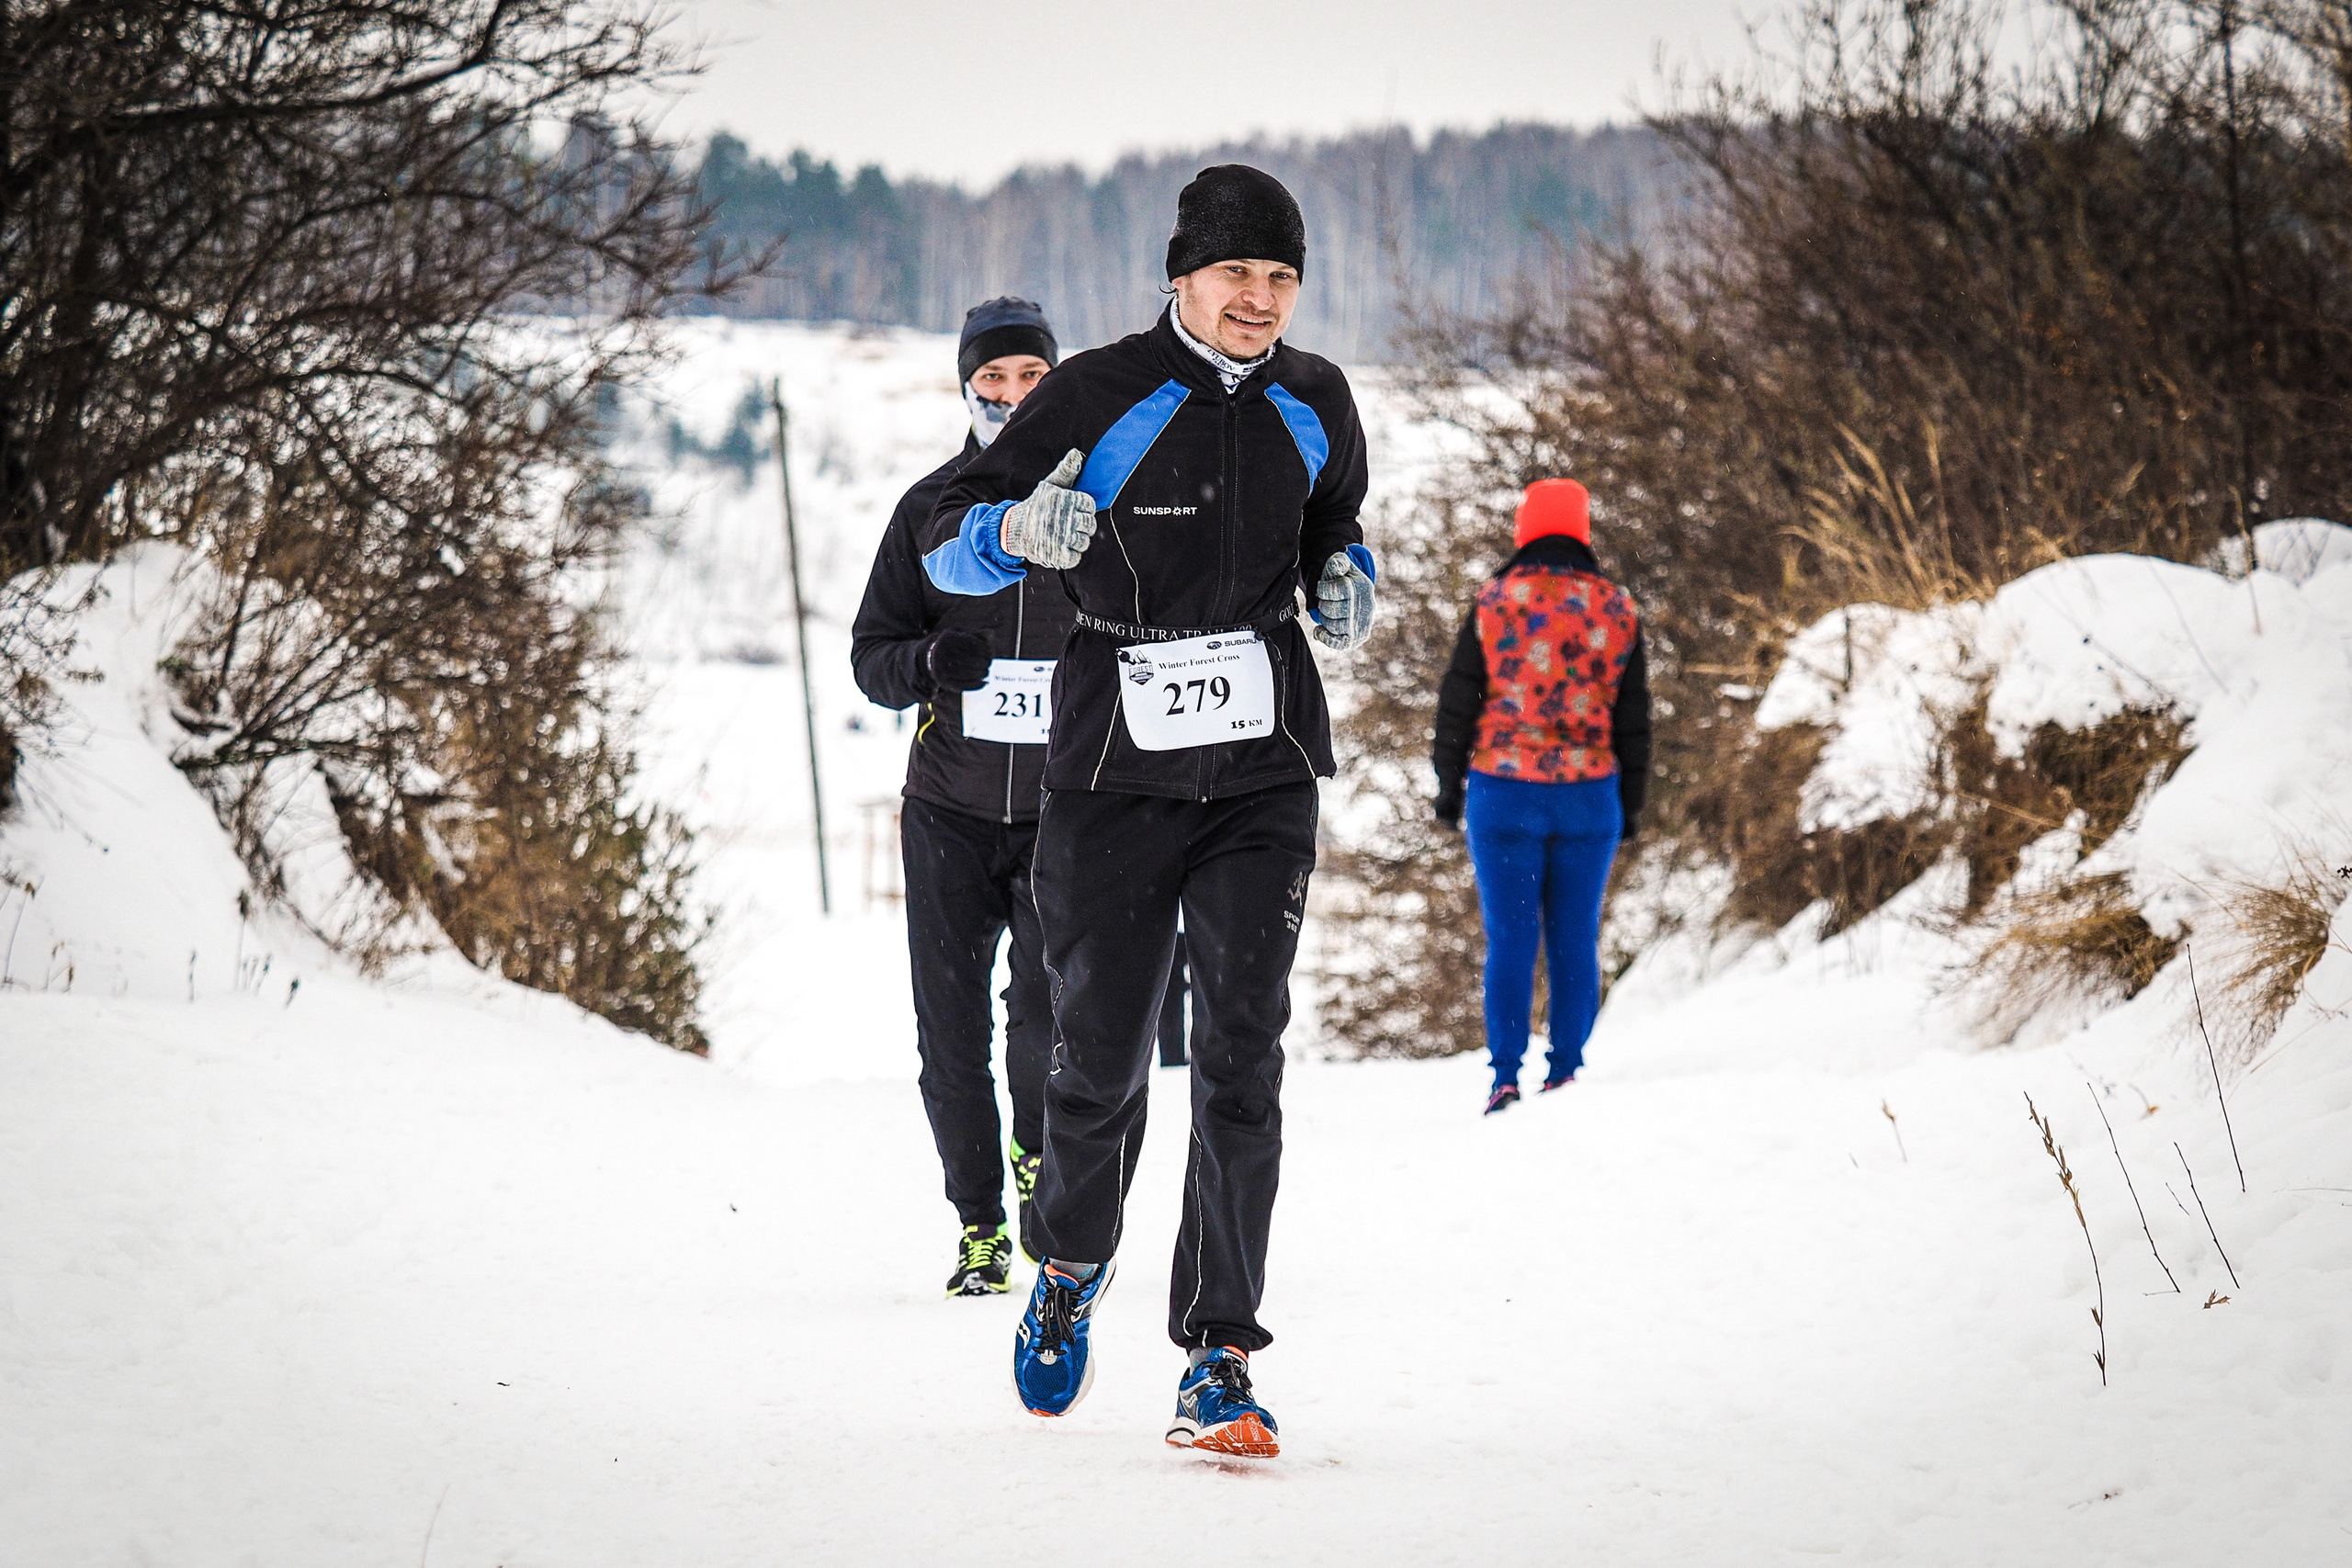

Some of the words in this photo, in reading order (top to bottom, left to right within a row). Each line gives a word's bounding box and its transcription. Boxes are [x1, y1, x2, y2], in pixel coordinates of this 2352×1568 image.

[1133, 506, 1198, 516] SUNSPORT
[1093, 617, 1125, 636] RING
[1129, 626, 1179, 641] ULTRA
[1225, 638, 1257, 647] SUBARU
[1159, 660, 1188, 670] Winter
[1190, 657, 1216, 667] Forest
[1217, 654, 1240, 662] Cross
[1163, 676, 1230, 716] 279
[994, 692, 1042, 717] 231
[1231, 720, 1246, 729] 15
[1249, 718, 1262, 727] KM
